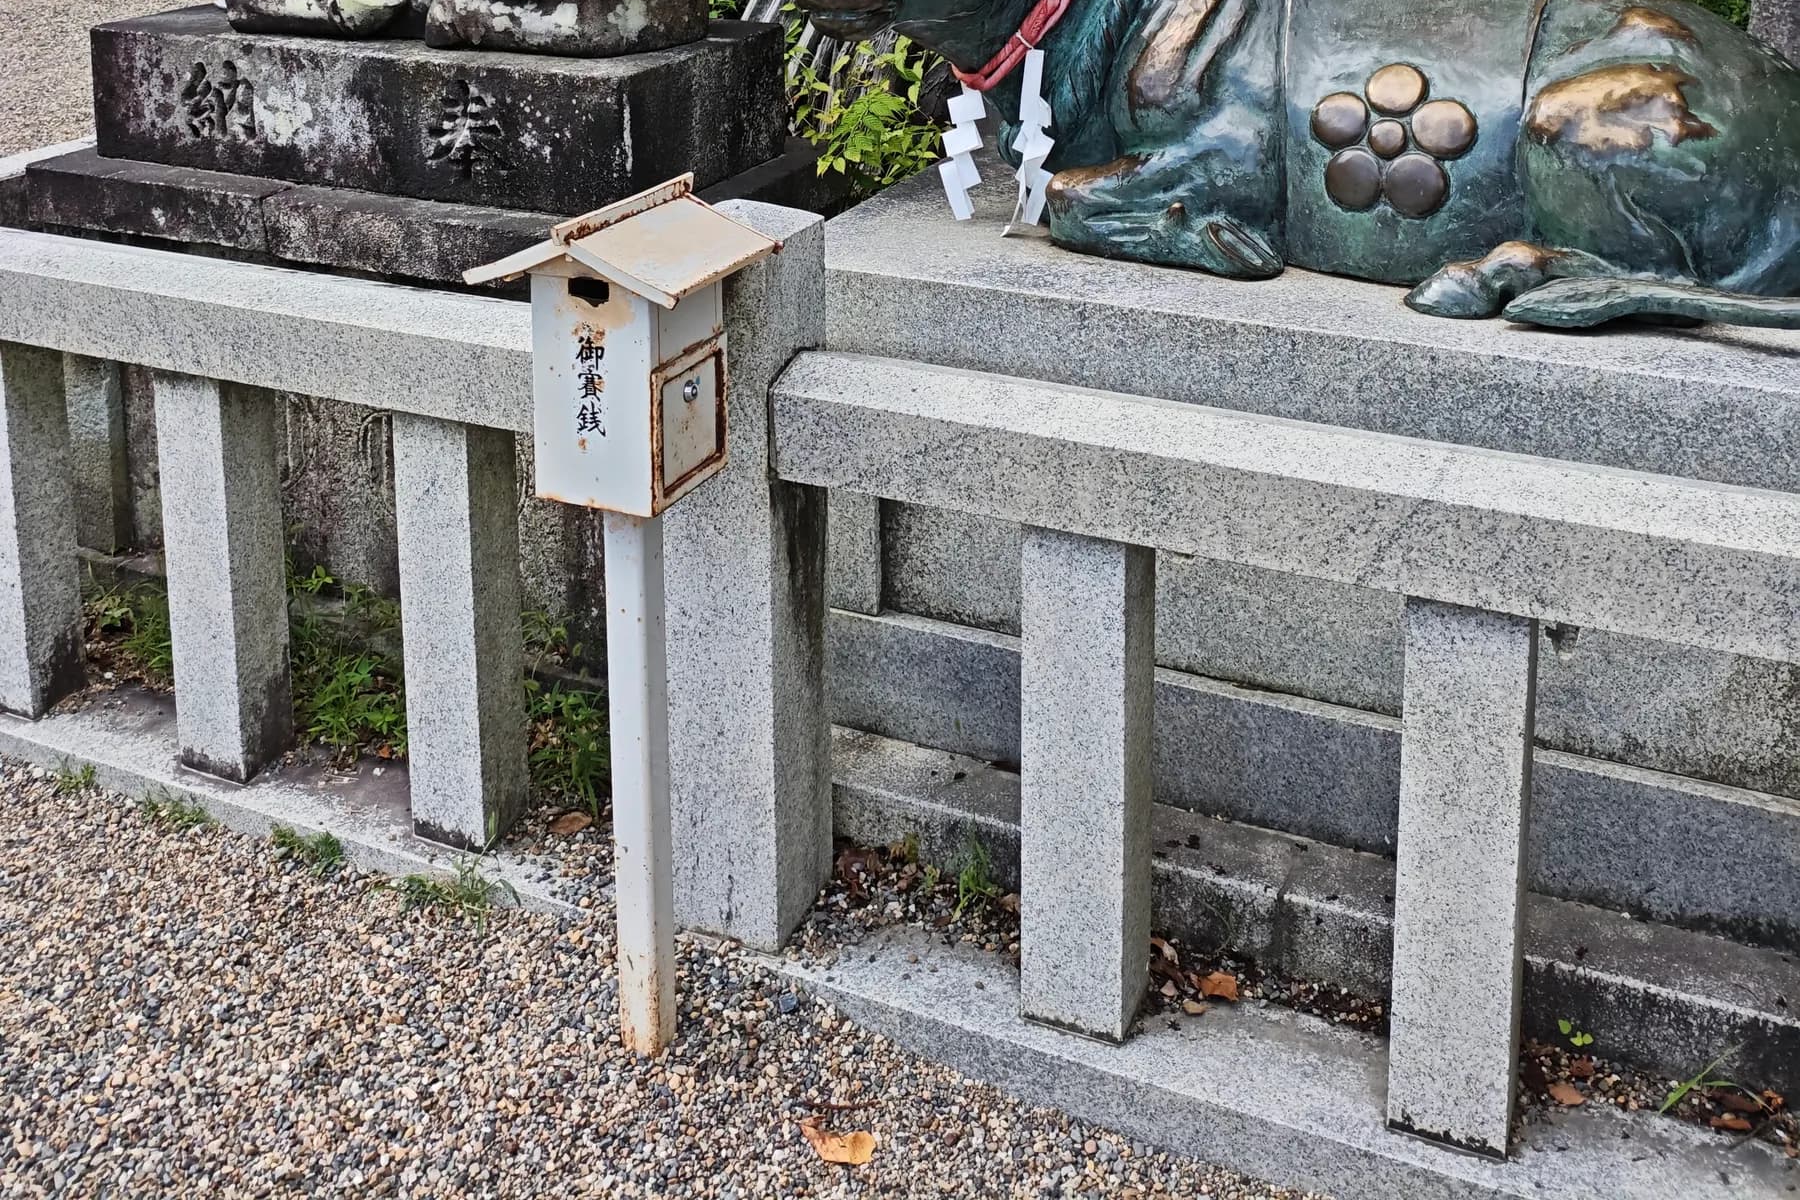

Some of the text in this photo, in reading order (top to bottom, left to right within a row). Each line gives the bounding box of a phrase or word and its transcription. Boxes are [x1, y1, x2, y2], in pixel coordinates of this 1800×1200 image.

[181, 59, 503, 180] 奉 納
[575, 336, 607, 438] 御賽銭
